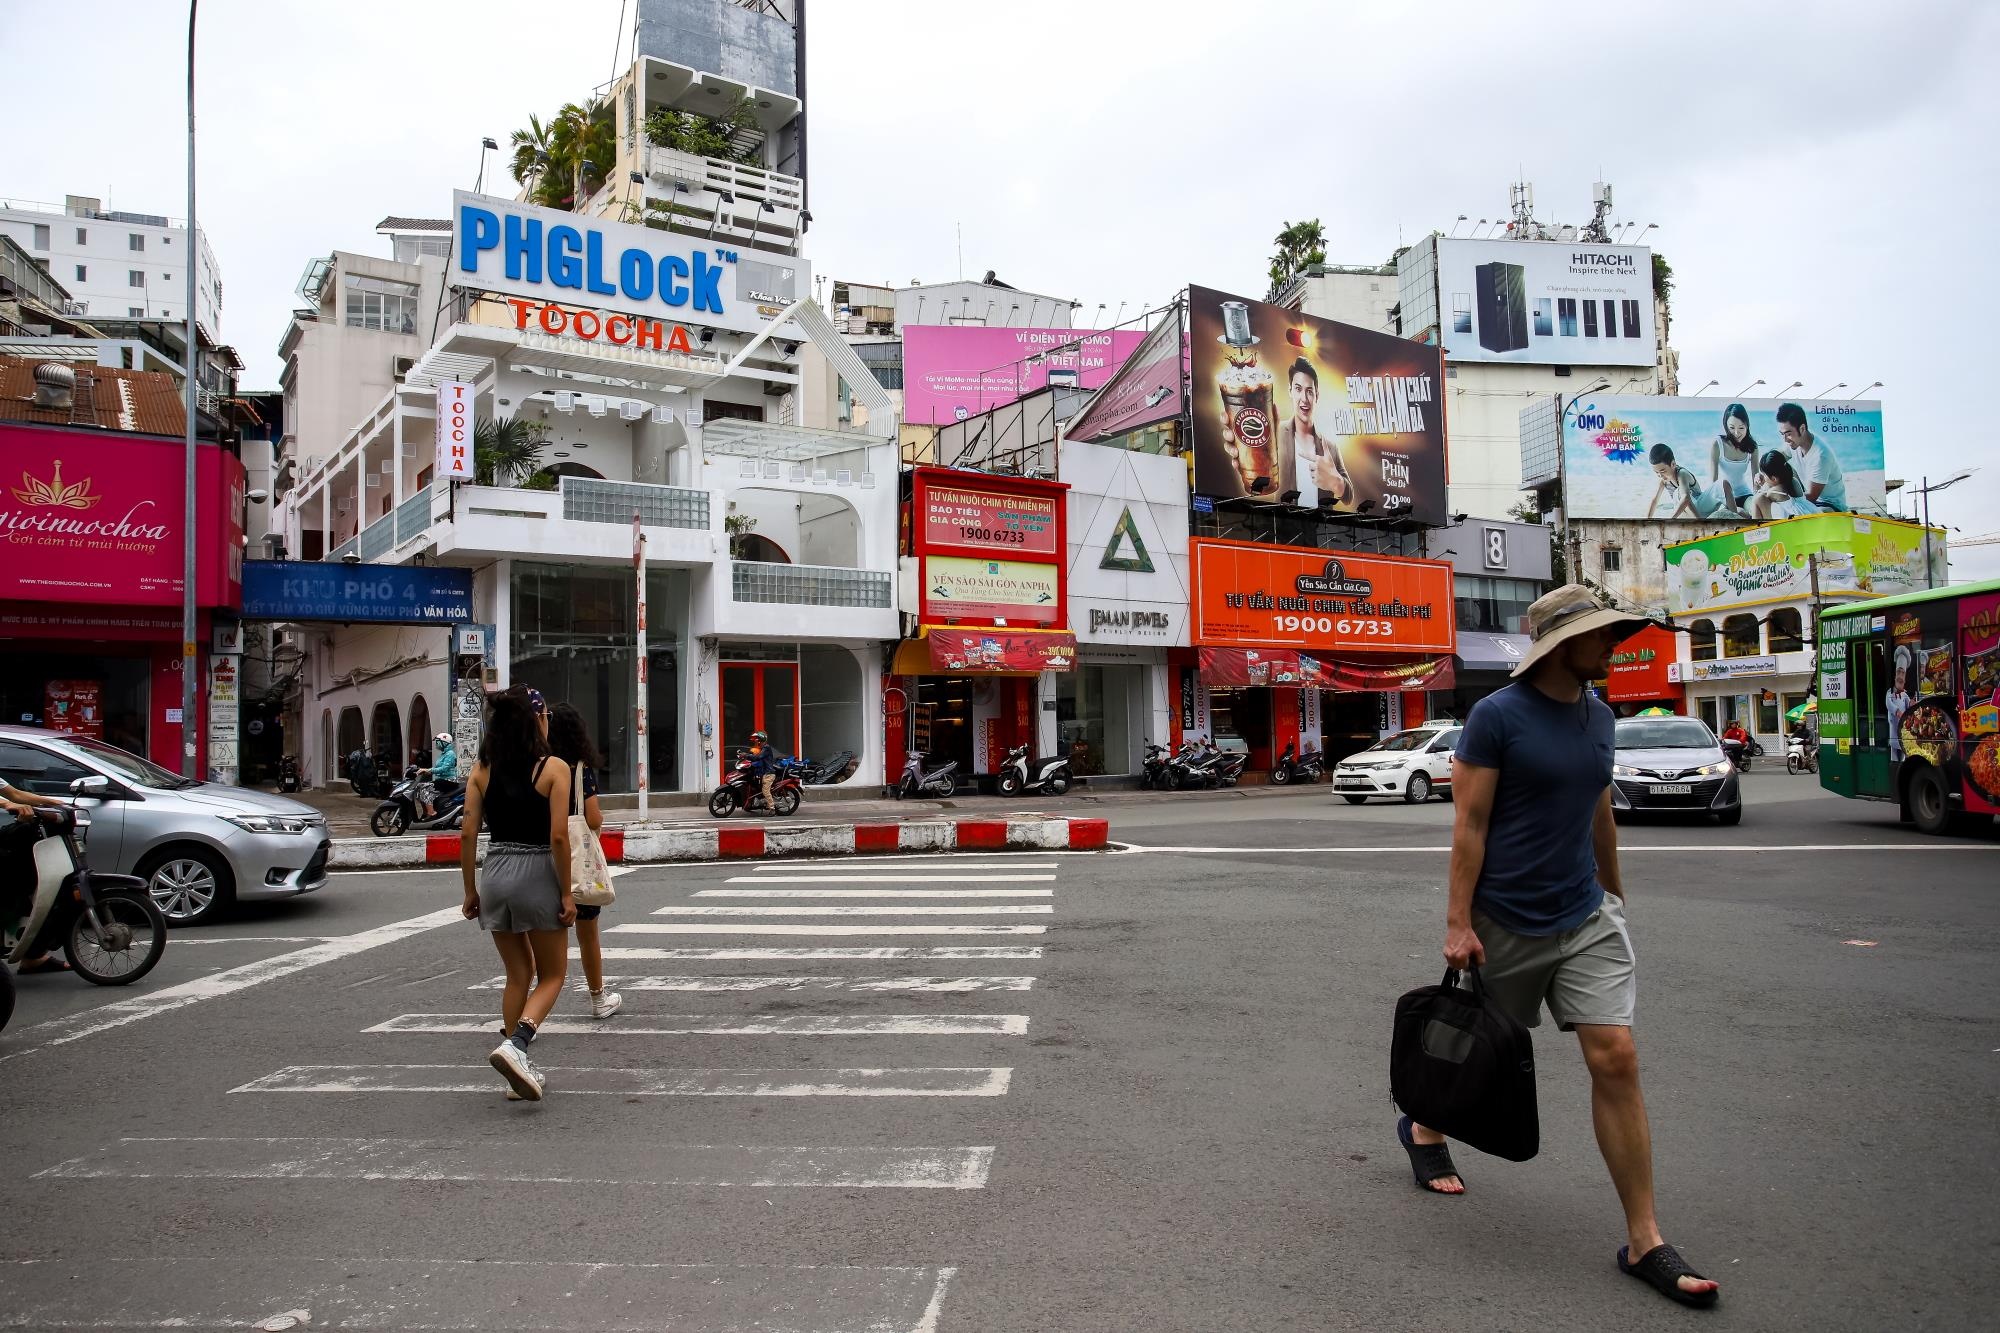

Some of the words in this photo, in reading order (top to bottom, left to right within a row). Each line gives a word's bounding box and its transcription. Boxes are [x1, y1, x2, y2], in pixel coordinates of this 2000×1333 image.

[1572, 253, 1633, 266] HITACHI
[1569, 265, 1599, 276] Inspire
[1601, 267, 1615, 275] the
[1617, 266, 1637, 275] Next
[508, 298, 693, 354] TOOCHA
[1015, 331, 1027, 343] VÍ
[1029, 332, 1056, 347] ĐIỆN
[1073, 335, 1112, 346] MOMO
[1052, 355, 1074, 368] VIỆT
[1079, 356, 1104, 367] NAM
[1234, 407, 1269, 427] HIGHLANDS
[1815, 403, 1836, 415] Lấm
[451, 386, 465, 471] TOOCHA
[1578, 414, 1605, 431] OMO
[1831, 423, 1850, 432] bên
[1851, 423, 1876, 432] nhau
[1241, 434, 1267, 446] COFFEE
[1381, 450, 1410, 460] HIGHLANDS
[941, 490, 959, 504] VẤN
[960, 494, 981, 506] NUÔI
[981, 496, 1002, 508] CHIM
[1038, 501, 1051, 513] PHÍ
[929, 515, 949, 525] GIA
[951, 516, 982, 527] CÔNG
[9, 532, 33, 545] Gợi
[87, 538, 113, 549] mùi
[959, 526, 992, 540] 1900
[993, 529, 1025, 543] 6733
[1490, 531, 1504, 564] 8
[282, 579, 336, 599] KHU
[344, 575, 394, 600] PHỐ
[402, 583, 416, 601] 4
[933, 571, 955, 585] YẾN
[956, 574, 977, 586] SÀO
[996, 577, 1018, 589] GÒN
[1018, 581, 1051, 591] ANPHA
[1315, 581, 1328, 590] Sào
[372, 605, 396, 616] KHU
[398, 602, 421, 617] PHỐ
[423, 604, 444, 618] VĂN
[446, 604, 468, 618] HÓA
[1226, 592, 1245, 607] TƯ
[1248, 590, 1275, 609] VẤN
[1278, 594, 1311, 612] NUÔI
[1314, 598, 1346, 613] CHIM
[1379, 597, 1410, 618] MIỄN
[1411, 602, 1433, 618] PHÍ
[1273, 615, 1332, 633] 1900
[1336, 619, 1393, 636] 6733
[1830, 618, 1841, 639] SON
[1840, 616, 1852, 638] NHAT
[1851, 614, 1872, 637] AIRPORT
